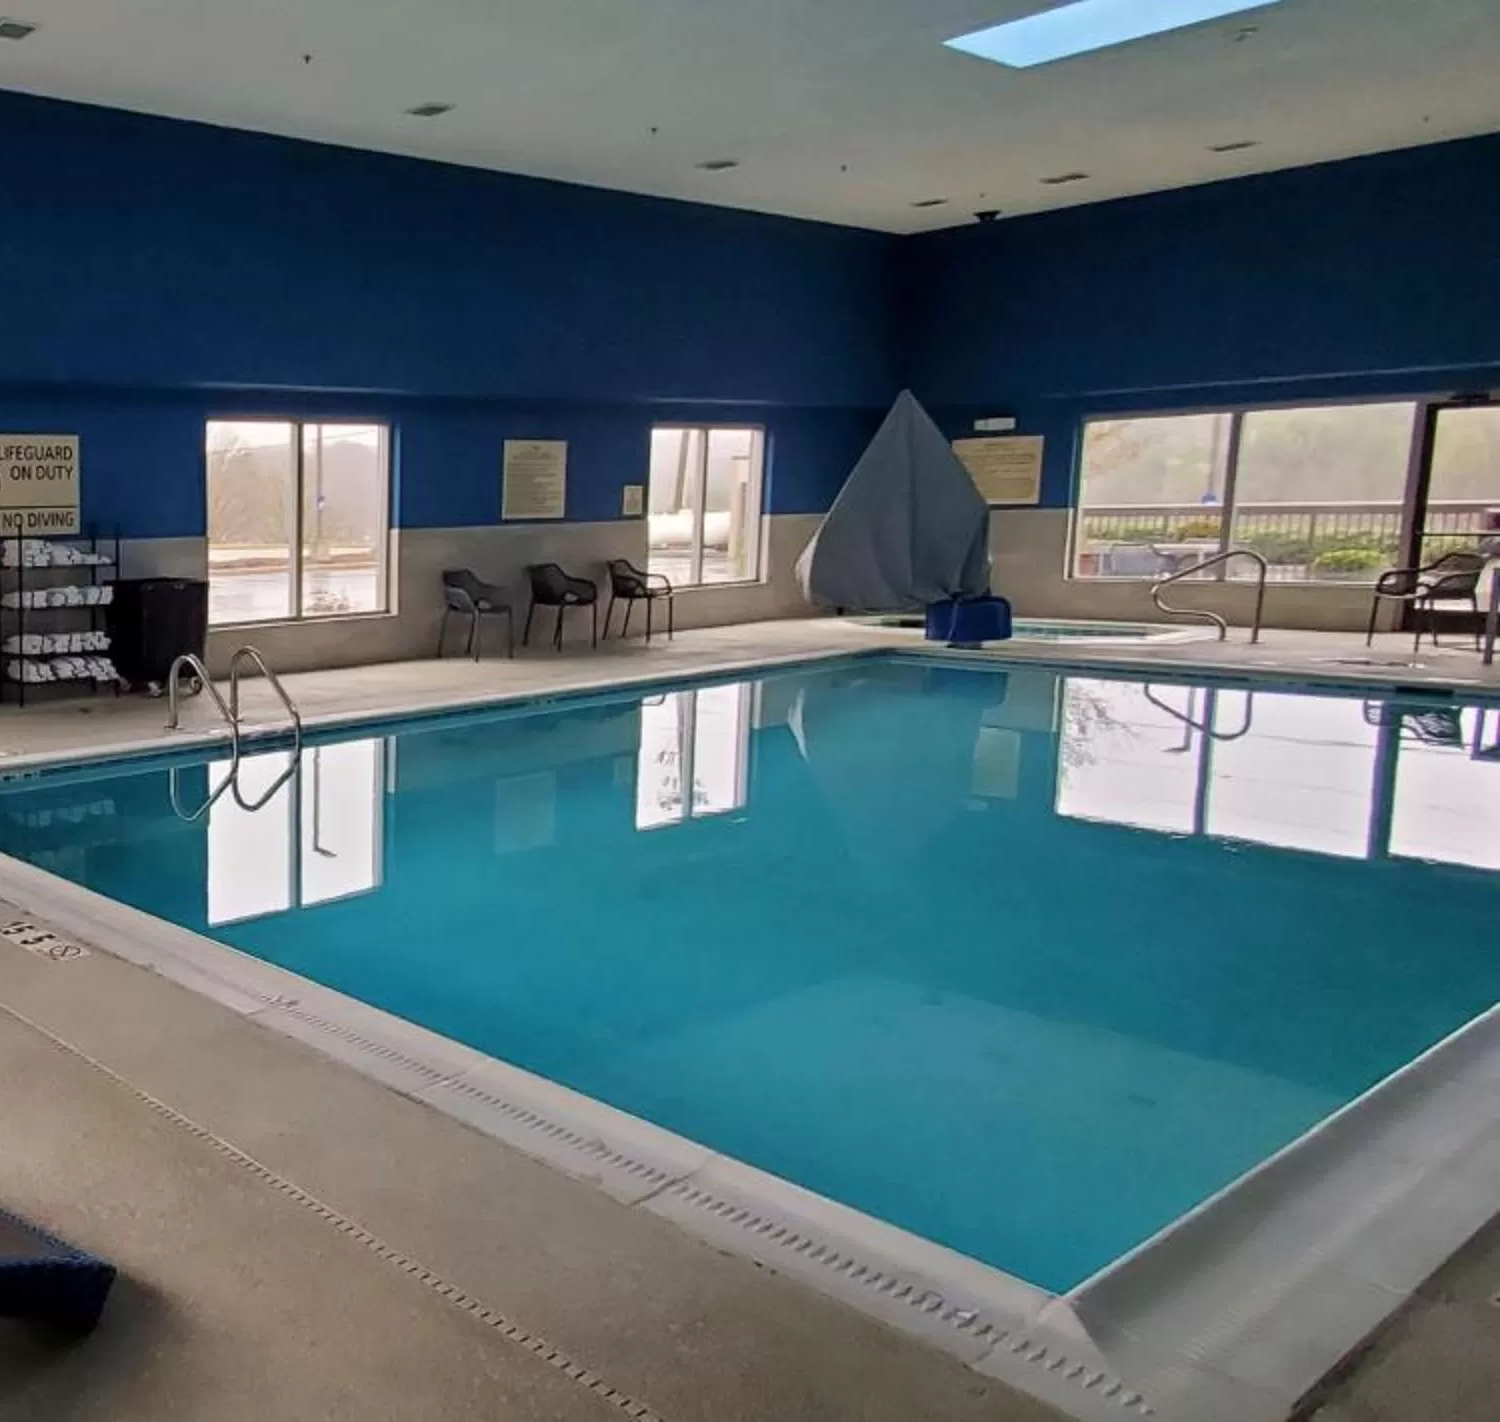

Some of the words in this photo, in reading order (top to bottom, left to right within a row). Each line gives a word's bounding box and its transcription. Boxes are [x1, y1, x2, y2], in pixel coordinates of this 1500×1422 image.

[10, 465, 31, 480] ON
[36, 465, 73, 480] DUTY
[2, 513, 23, 528] NO
[27, 512, 74, 528] DIVING
